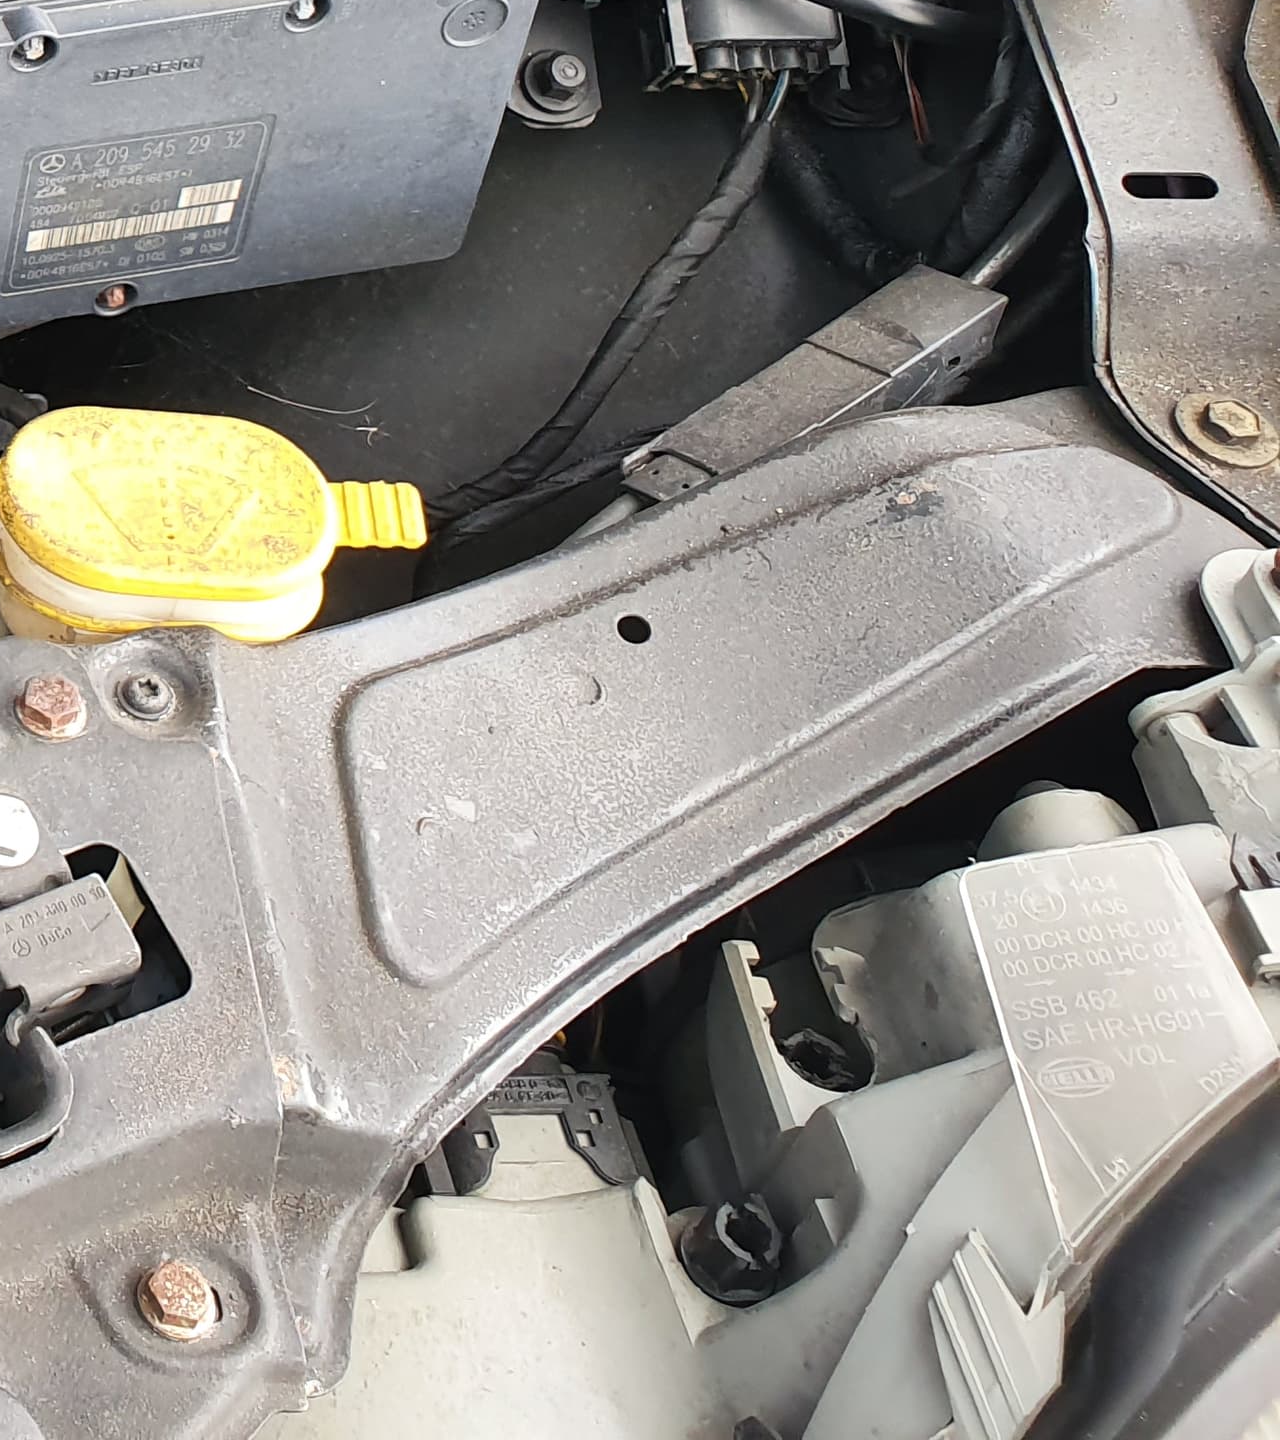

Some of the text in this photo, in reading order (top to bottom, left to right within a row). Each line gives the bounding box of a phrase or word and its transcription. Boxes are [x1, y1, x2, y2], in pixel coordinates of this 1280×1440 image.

[71, 129, 246, 170] A 209 545 29 32
[994, 936, 1020, 955] 00
[1025, 930, 1073, 952] DCR
[1077, 925, 1103, 944] 00
[1109, 920, 1141, 941] HC
[1146, 918, 1170, 936] 00
[1003, 958, 1029, 978] 00
[1034, 952, 1082, 974] DCR
[1086, 948, 1113, 968] 00
[1117, 942, 1150, 963] HC
[1012, 994, 1068, 1022] SSB
[1074, 988, 1118, 1012] 462
[1022, 1024, 1083, 1051] SAE
[1114, 1043, 1177, 1068] VOL
